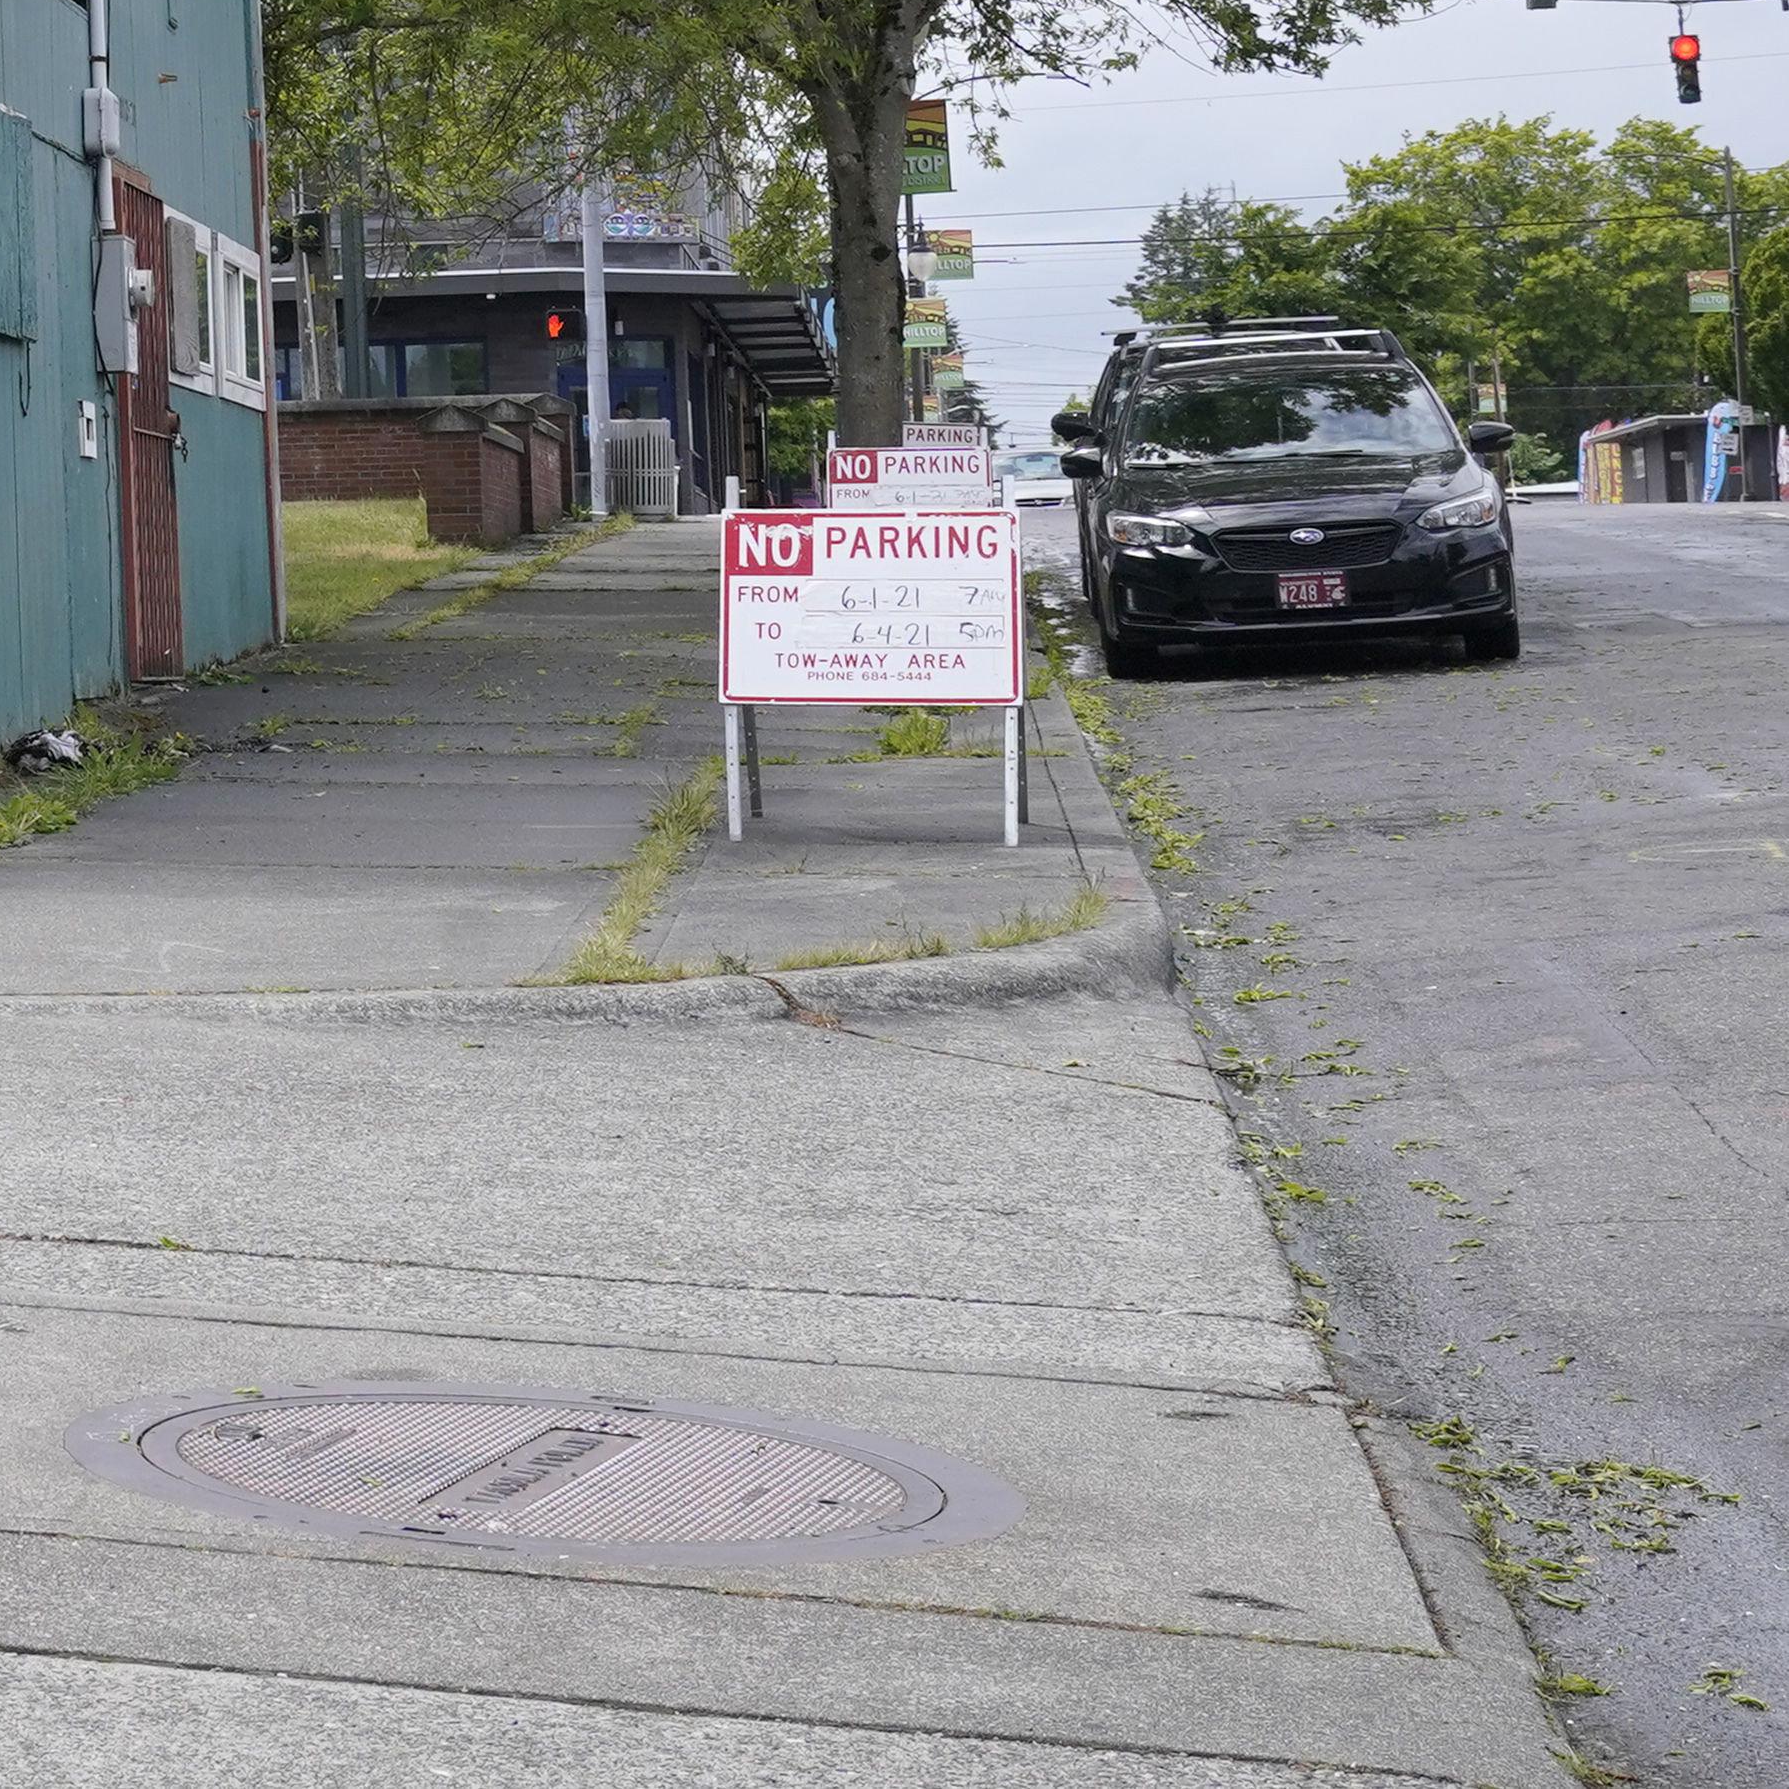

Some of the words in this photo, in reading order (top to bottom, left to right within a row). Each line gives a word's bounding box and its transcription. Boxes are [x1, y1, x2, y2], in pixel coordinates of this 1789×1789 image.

[934, 258, 972, 270] LLTOP
[903, 326, 945, 338] HILLTOP
[906, 427, 973, 443] PARKING
[836, 454, 872, 480] NO
[884, 455, 980, 474] PARKING
[836, 489, 871, 499] FROM
[738, 523, 802, 568] NO
[825, 525, 999, 559] PARKING
[737, 586, 800, 603] FROM
[754, 622, 782, 639] TO
[851, 622, 930, 646] 6-4-21
[775, 652, 888, 669] TOW-AWAY
[907, 653, 967, 669] AREA
[807, 671, 854, 681] PHONE
[861, 671, 932, 681] 684-5444
